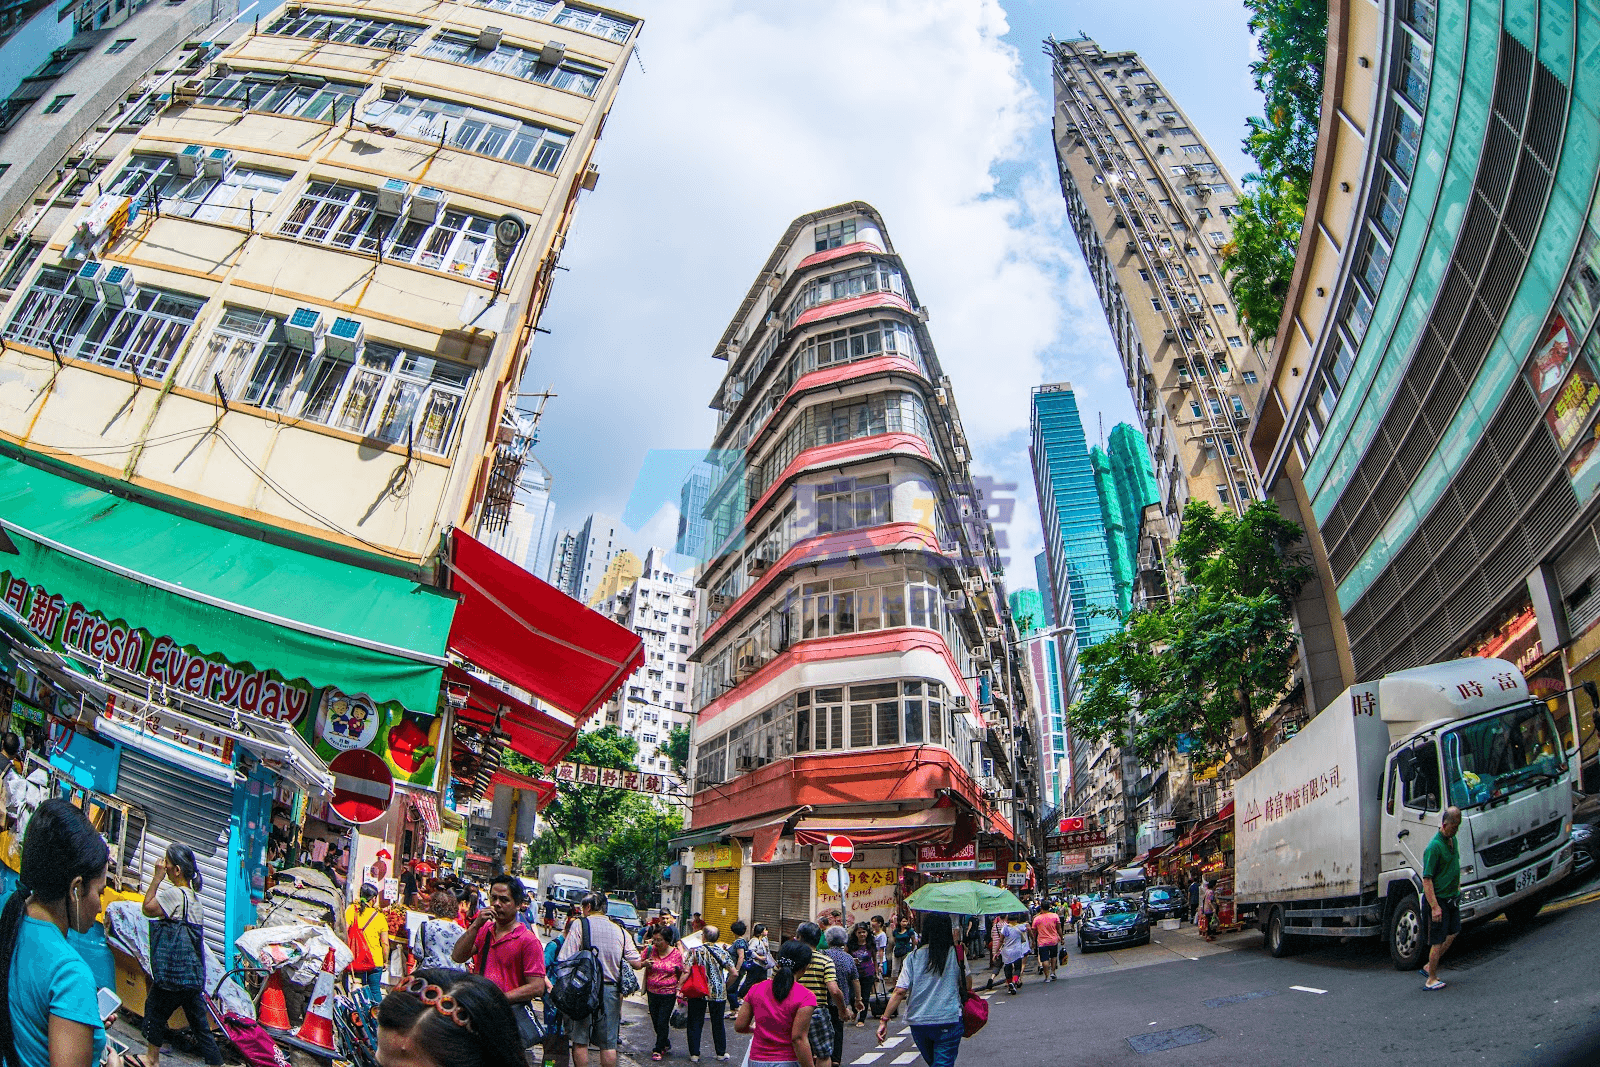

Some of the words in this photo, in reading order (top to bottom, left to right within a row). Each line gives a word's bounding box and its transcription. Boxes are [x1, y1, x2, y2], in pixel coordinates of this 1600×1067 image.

[4, 577, 66, 640] 日新
[61, 601, 143, 671] Fresh
[145, 636, 308, 723] Everyday
[1457, 673, 1517, 699] 時富
[1352, 691, 1376, 717] 時
[853, 886, 872, 898] and
